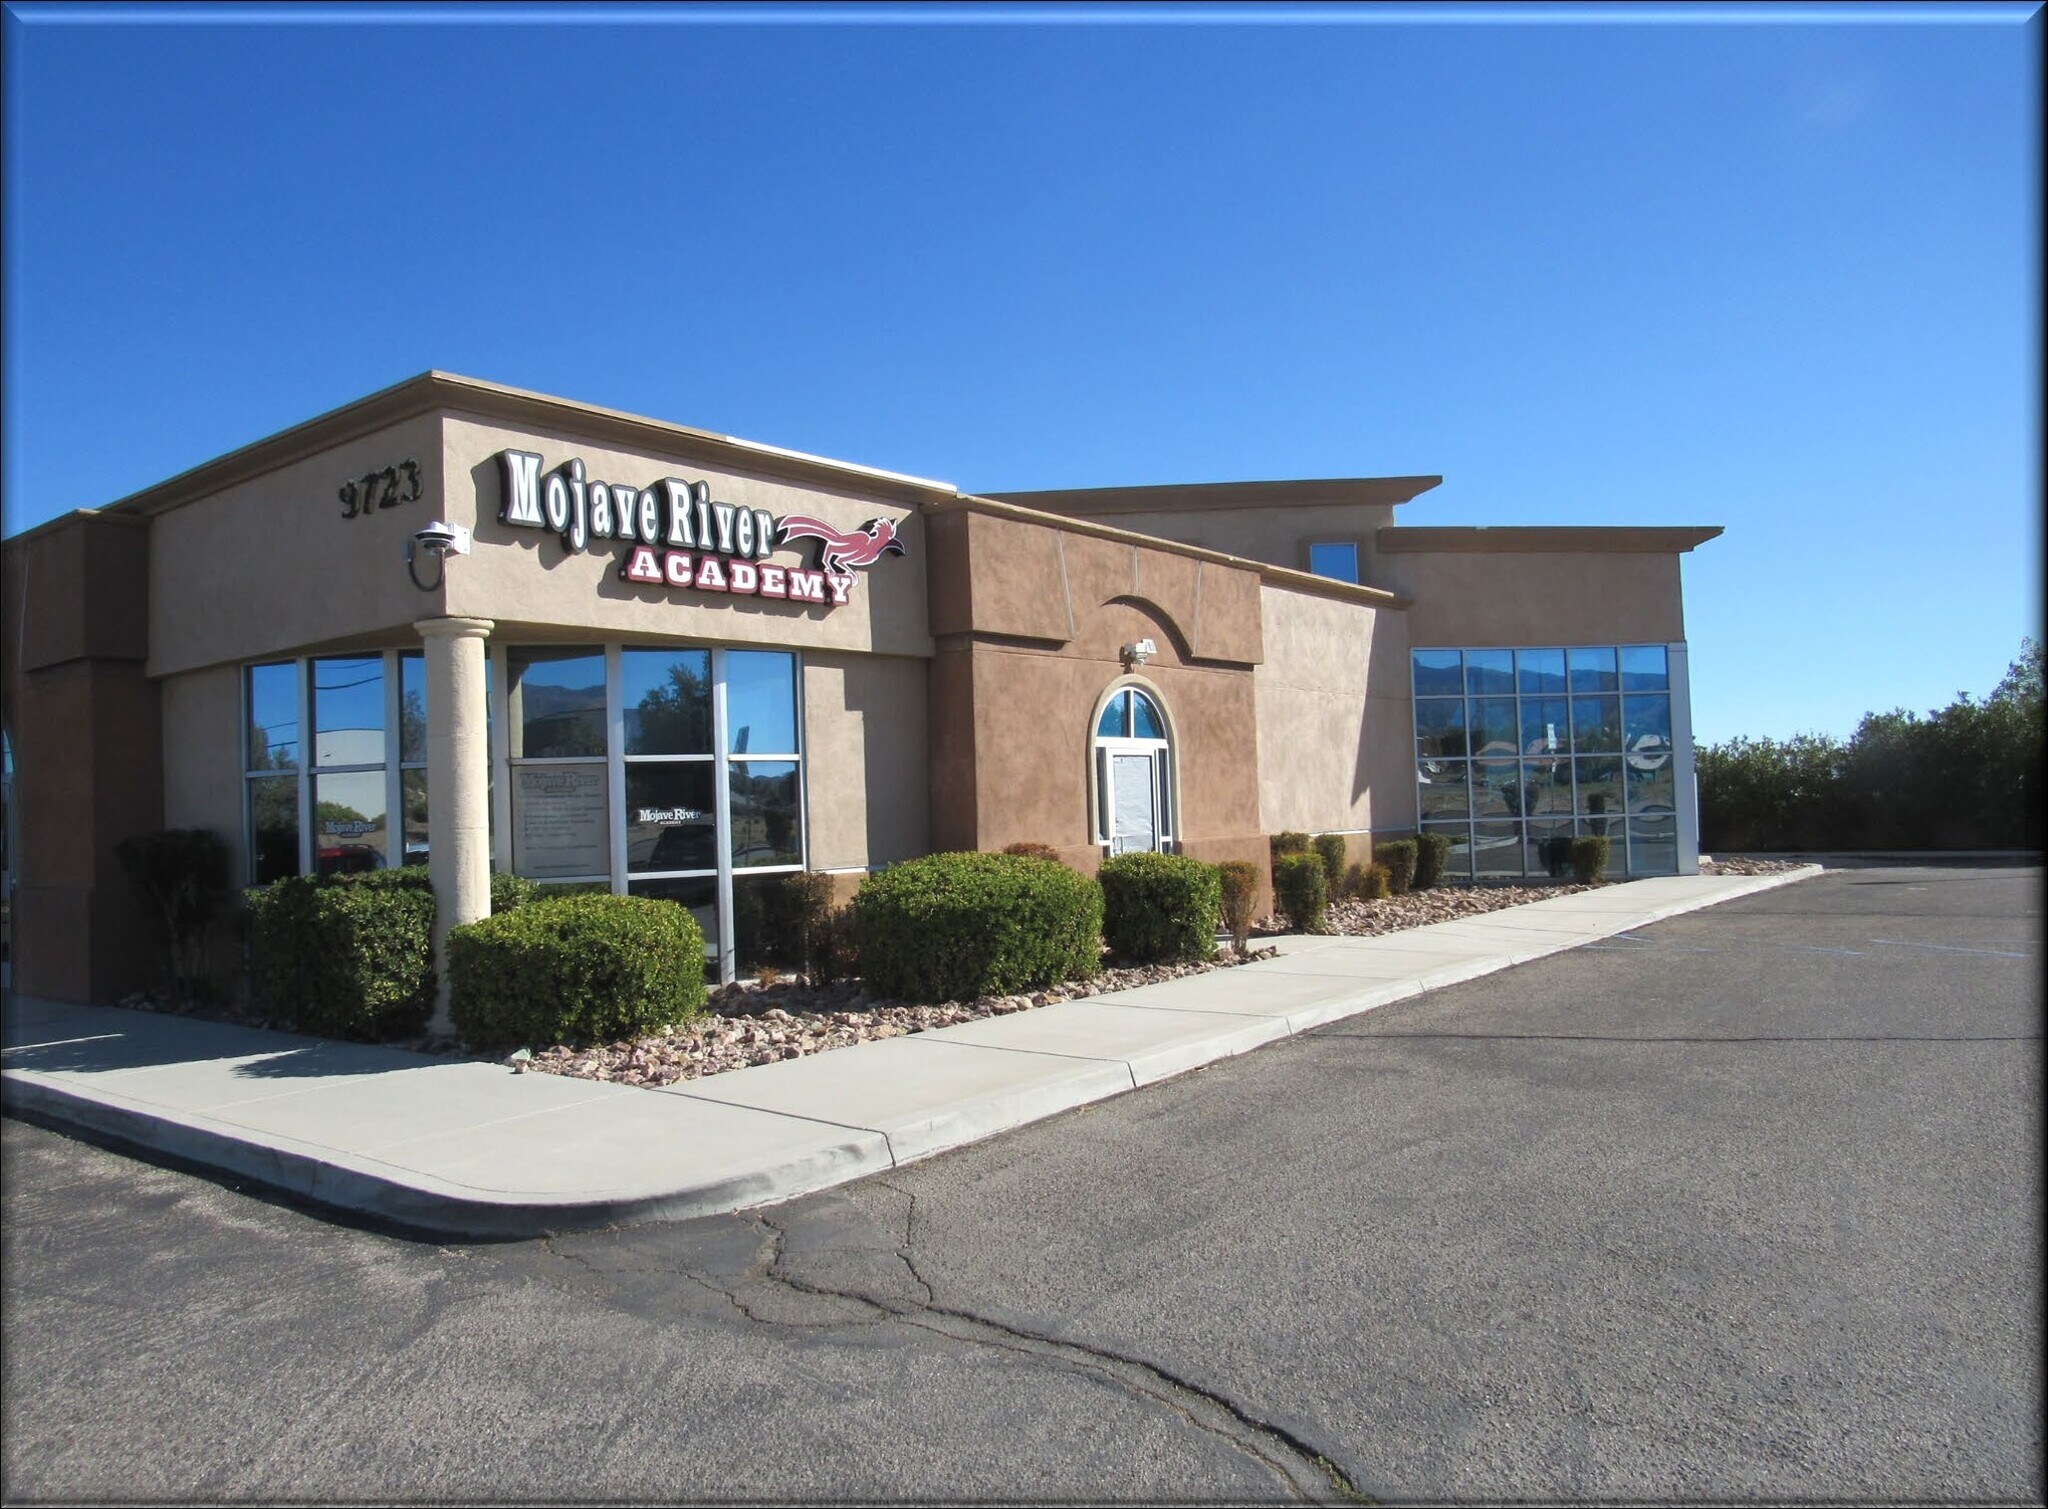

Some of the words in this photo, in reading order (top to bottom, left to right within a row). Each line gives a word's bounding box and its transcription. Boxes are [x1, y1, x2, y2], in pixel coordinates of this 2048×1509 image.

[339, 458, 422, 518] 9723
[505, 449, 659, 554] Mojave
[665, 477, 774, 558] River
[628, 546, 851, 605] ACADEMY
[638, 808, 674, 823] Mojave
[674, 808, 701, 820] River
